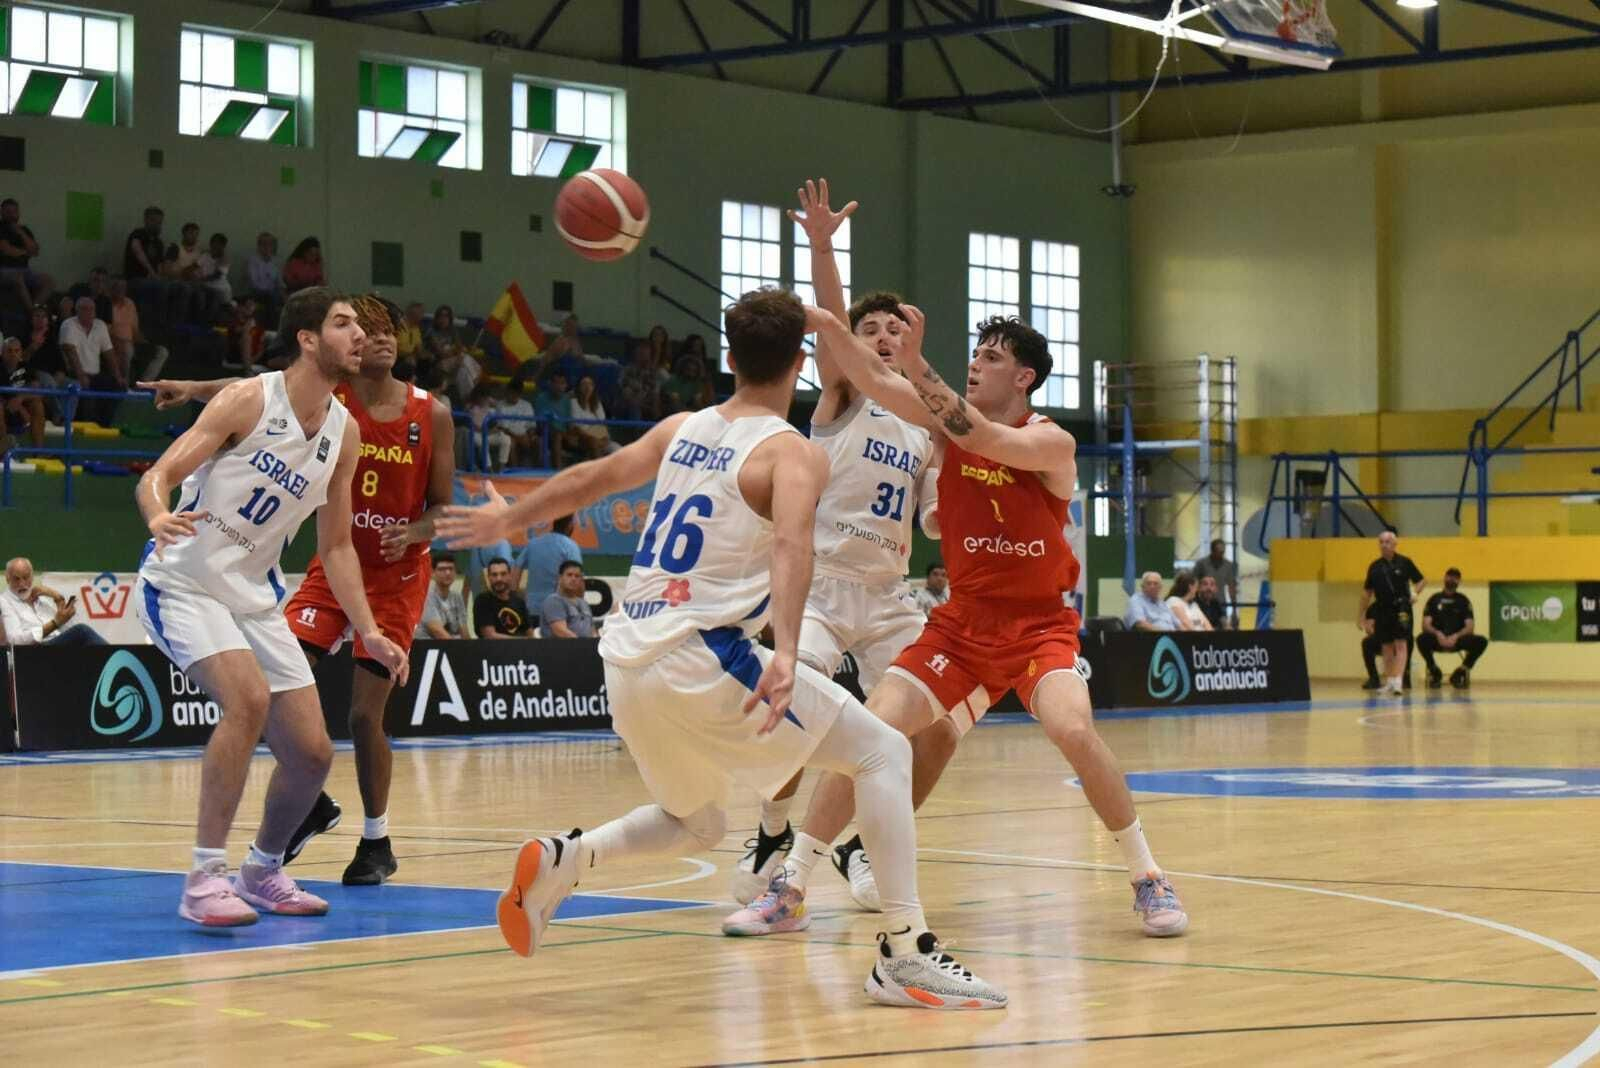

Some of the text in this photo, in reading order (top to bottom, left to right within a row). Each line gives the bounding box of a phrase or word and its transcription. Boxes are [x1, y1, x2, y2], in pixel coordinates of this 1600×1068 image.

[359, 443, 413, 465] SPAÑA
[248, 449, 310, 500] ISRAEL
[361, 470, 379, 497] 8
[237, 486, 281, 526] 10
[870, 482, 905, 522] 31
[989, 498, 1004, 523] 1
[631, 493, 714, 574] 16
[1192, 644, 1269, 669] baloncesto
[477, 659, 541, 688] Junta
[480, 684, 612, 721] de Andalucí
